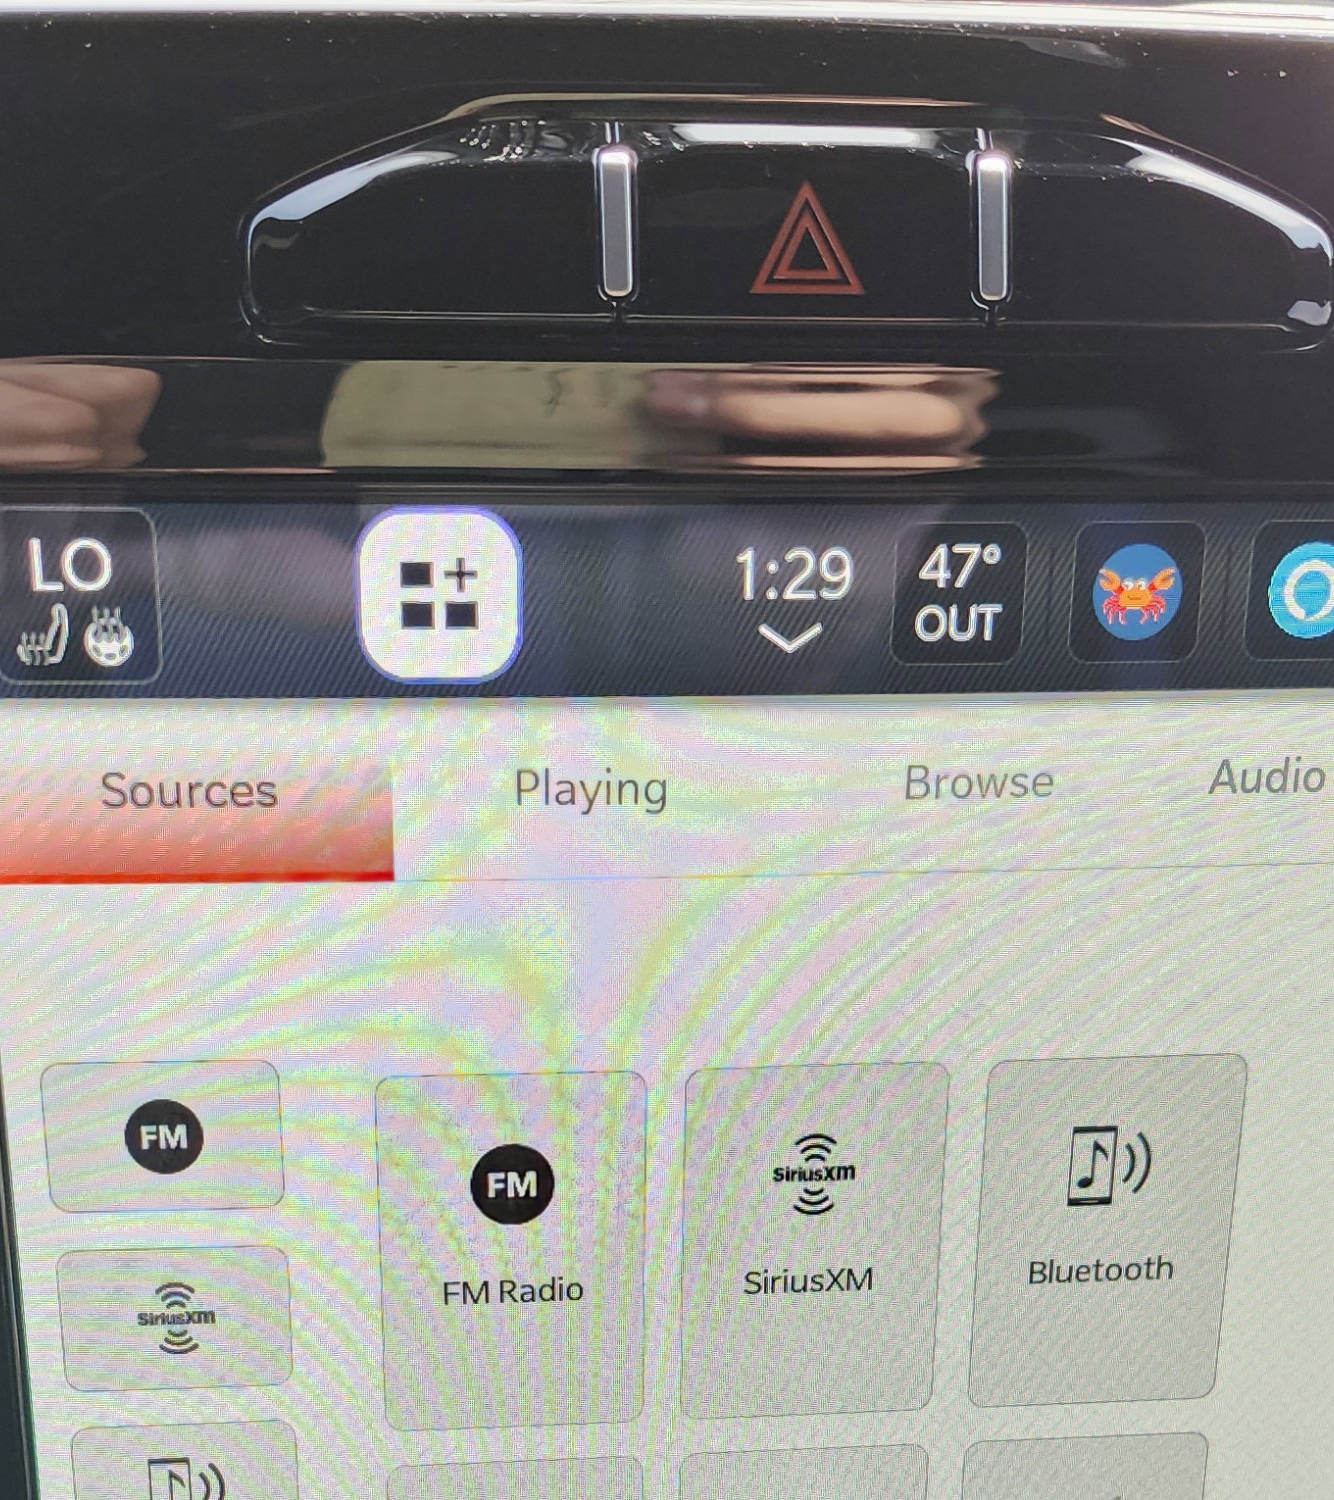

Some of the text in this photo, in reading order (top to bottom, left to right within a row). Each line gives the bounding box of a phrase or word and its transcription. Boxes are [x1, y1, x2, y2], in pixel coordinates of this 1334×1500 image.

[28, 537, 112, 592] LO
[736, 546, 854, 601] 1:29
[918, 543, 1002, 589] 47°
[914, 604, 1003, 642] OUT
[101, 772, 278, 809] Sources
[516, 767, 668, 814] Playing
[904, 764, 1055, 801] Browse
[1209, 757, 1327, 797] Audio
[139, 1126, 187, 1150] FM
[487, 1173, 538, 1198] FM
[743, 1267, 874, 1295] SiriusXM
[1028, 1256, 1174, 1285] Bluetooth
[443, 1278, 584, 1306] FM Radio
